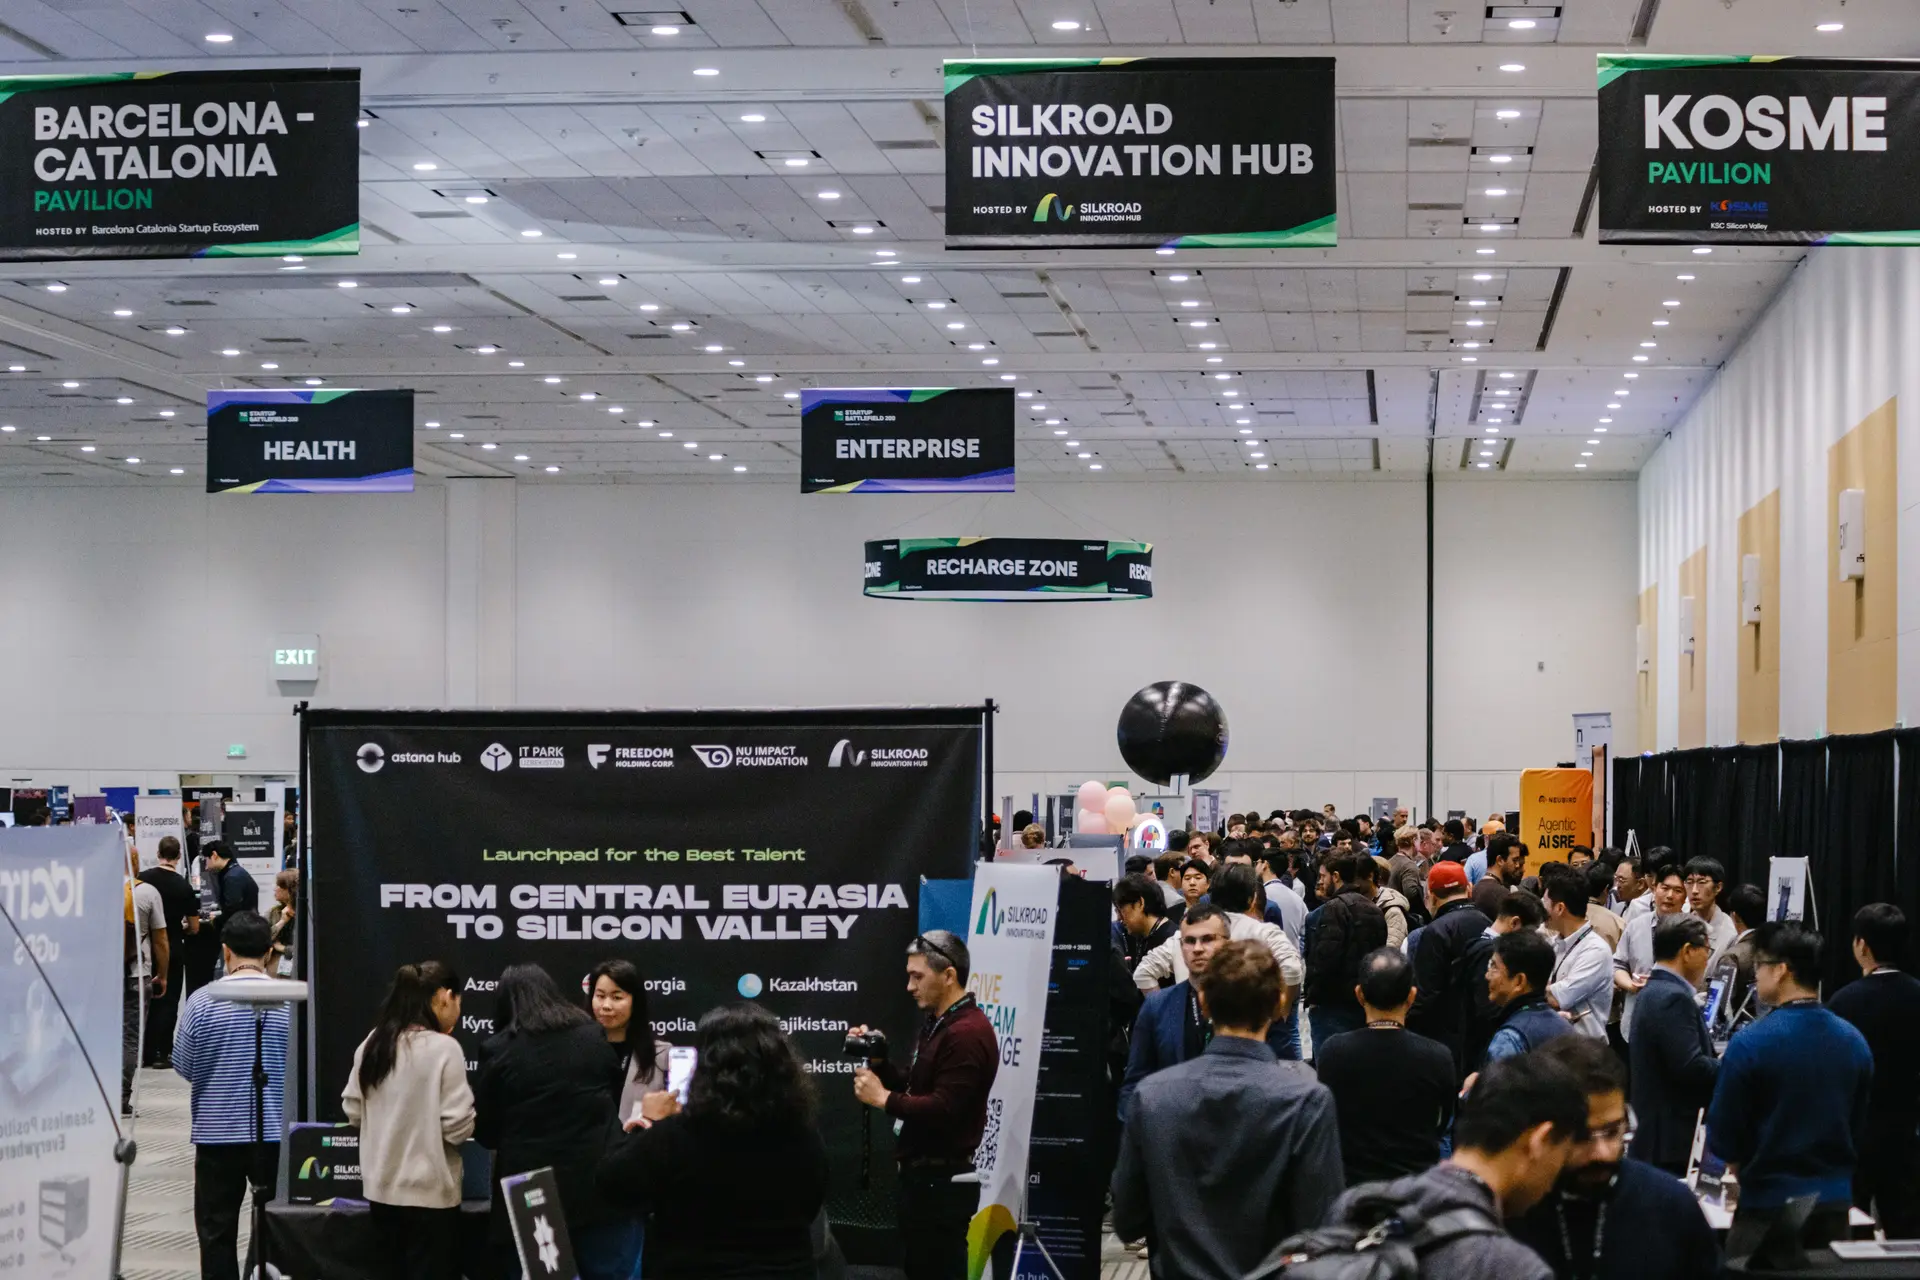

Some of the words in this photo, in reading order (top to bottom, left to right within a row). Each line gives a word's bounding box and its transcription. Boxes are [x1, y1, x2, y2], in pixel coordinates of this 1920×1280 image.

[35, 101, 288, 140] BARCELONA
[297, 113, 314, 121] -
[972, 104, 1173, 136] SILKROAD
[1644, 94, 1887, 150] KOSME
[34, 143, 278, 181] CATALONIA
[972, 144, 1221, 178] INNOVATION
[1232, 143, 1314, 175] HUB
[1649, 162, 1771, 184] PAVILION
[34, 188, 153, 211] PAVILION
[973, 206, 1012, 214] HOSTED
[1015, 205, 1028, 214] BY
[1080, 202, 1142, 214] SILKROAD
[1690, 206, 1702, 214] BY
[36, 227, 73, 236] HOSTED
[76, 227, 87, 235] BY
[92, 224, 134, 235] Barcelona
[136, 223, 177, 234] Catalonia
[178, 222, 211, 235] Startup
[213, 222, 259, 234] Ecosystem
[1749, 222, 1768, 231] Valley
[264, 440, 356, 460] HEALTH
[836, 438, 980, 458] ENTERPRISE
[927, 560, 1025, 576] RECHARGE
[1028, 560, 1078, 576] ZONE
[275, 649, 316, 664] EXIT
[392, 753, 434, 763] astana
[438, 752, 461, 763] hub
[520, 746, 530, 756] IT
[532, 746, 564, 757] PARK
[616, 748, 673, 758] FREEDOM
[736, 746, 751, 755] NU
[754, 746, 796, 756] IMPACT
[871, 749, 928, 759] SILKROAD
[736, 756, 808, 766] FOUNDATION
[871, 760, 912, 768] INNOVATION
[1538, 817, 1576, 833] Agentic
[1538, 835, 1550, 848] AI
[1552, 835, 1575, 848] SRE
[483, 848, 599, 865] Launchpad
[605, 848, 637, 861] for
[644, 848, 680, 861] the
[686, 849, 735, 861] Best
[742, 849, 806, 861] Talent
[380, 884, 497, 908] FROM
[510, 884, 710, 909] CENTRAL
[723, 884, 908, 909] EURASIA
[1008, 906, 1048, 924] SILKROAD
[447, 914, 504, 940] TO
[516, 915, 682, 940] SILICON
[696, 915, 858, 940] VALLEY
[464, 978, 499, 992] Azer
[644, 977, 686, 995] orgia
[770, 977, 858, 992] Kazakhstan
[462, 1016, 494, 1034] Kyrg
[649, 1017, 696, 1036] ngolia
[803, 1059, 862, 1074] ekistan
[334, 1165, 361, 1174] SILKR
